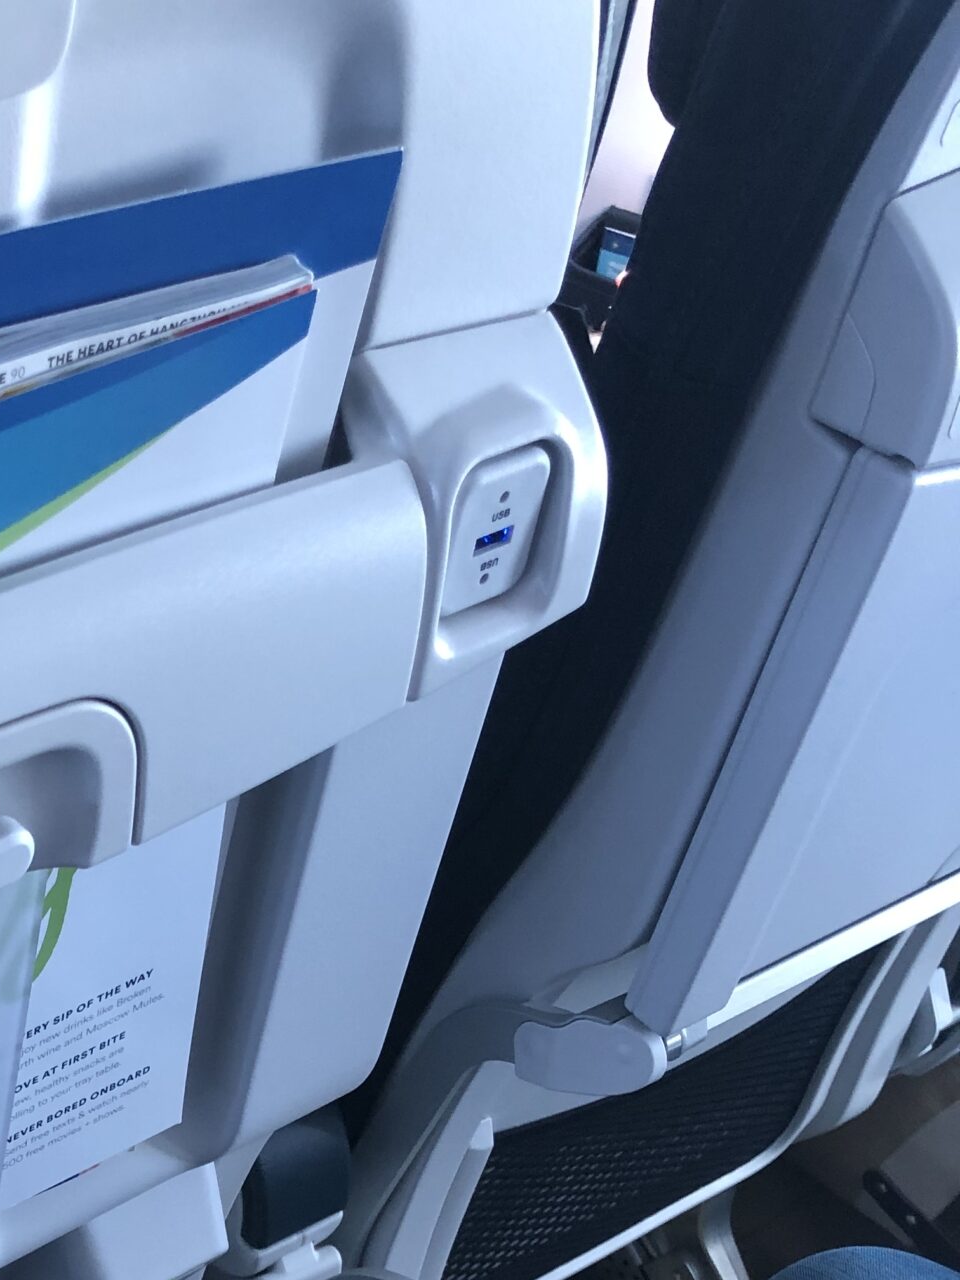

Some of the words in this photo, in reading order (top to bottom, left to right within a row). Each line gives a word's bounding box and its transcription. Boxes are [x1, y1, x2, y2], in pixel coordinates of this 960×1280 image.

[47, 350, 75, 369] THE
[77, 337, 124, 361] HEART
[126, 329, 147, 344] OF
[9, 365, 26, 381] 90
[492, 508, 511, 523] USB
[24, 1021, 50, 1039] ERY
[52, 1009, 74, 1026] SIP
[76, 998, 94, 1014] OF
[96, 984, 121, 1003] THE
[125, 968, 154, 989] WAY
[39, 1031, 62, 1047] new
[63, 1014, 94, 1034] drinks
[96, 1004, 114, 1017] like
[116, 985, 152, 1008] Broken
[64, 1031, 83, 1047] and
[85, 1010, 130, 1036] Moscow
[34, 1073, 70, 1095] healthy
[73, 1054, 107, 1077] snacks
[108, 1046, 125, 1059] are
[42, 1066, 58, 1080] AT
[61, 1046, 96, 1070] FIRST
[99, 1031, 126, 1050] BITE
[6, 1119, 43, 1144] NEVER
[46, 1098, 87, 1123] BORED
[90, 1065, 151, 1100] ONBOARD
[51, 1084, 73, 1103] your
[75, 1074, 95, 1089] tray
[30, 1128, 50, 1144] free
[88, 1096, 118, 1114] watch
[47, 1125, 82, 1146] movies
